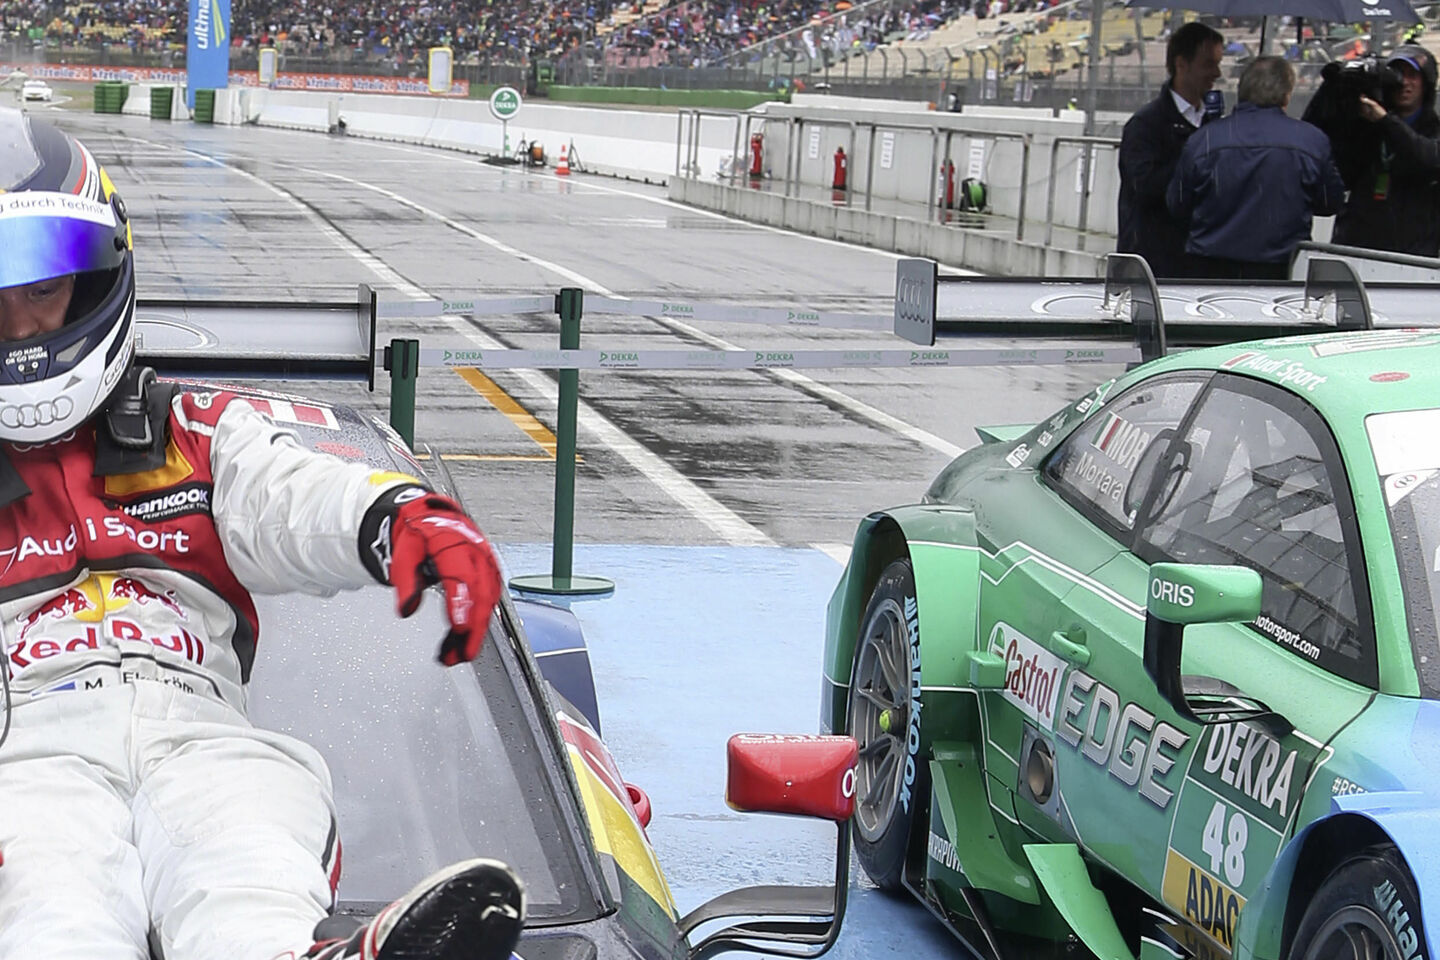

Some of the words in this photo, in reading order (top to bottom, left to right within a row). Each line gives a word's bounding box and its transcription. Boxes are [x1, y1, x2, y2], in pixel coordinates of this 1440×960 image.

[10, 197, 55, 209] durch
[60, 197, 106, 216] Technik
[454, 351, 483, 361] DEKRA
[610, 351, 639, 361] DEKRA
[765, 351, 795, 361] DEKRA
[921, 350, 949, 361] DEKRA
[1076, 349, 1105, 359] DEKRA
[1246, 353, 1284, 378] Audi
[1276, 358, 1329, 391] Sport
[1105, 417, 1149, 472] MOR
[1074, 450, 1126, 500] Mortara
[123, 488, 209, 517] Hankook
[1151, 577, 1196, 608] ORIS
[1004, 639, 1058, 719] Castrol
[1056, 668, 1191, 810] EDGE
[1203, 713, 1298, 818] DEKRA
[1202, 800, 1249, 888] 48
[1185, 867, 1240, 949] ADAC
